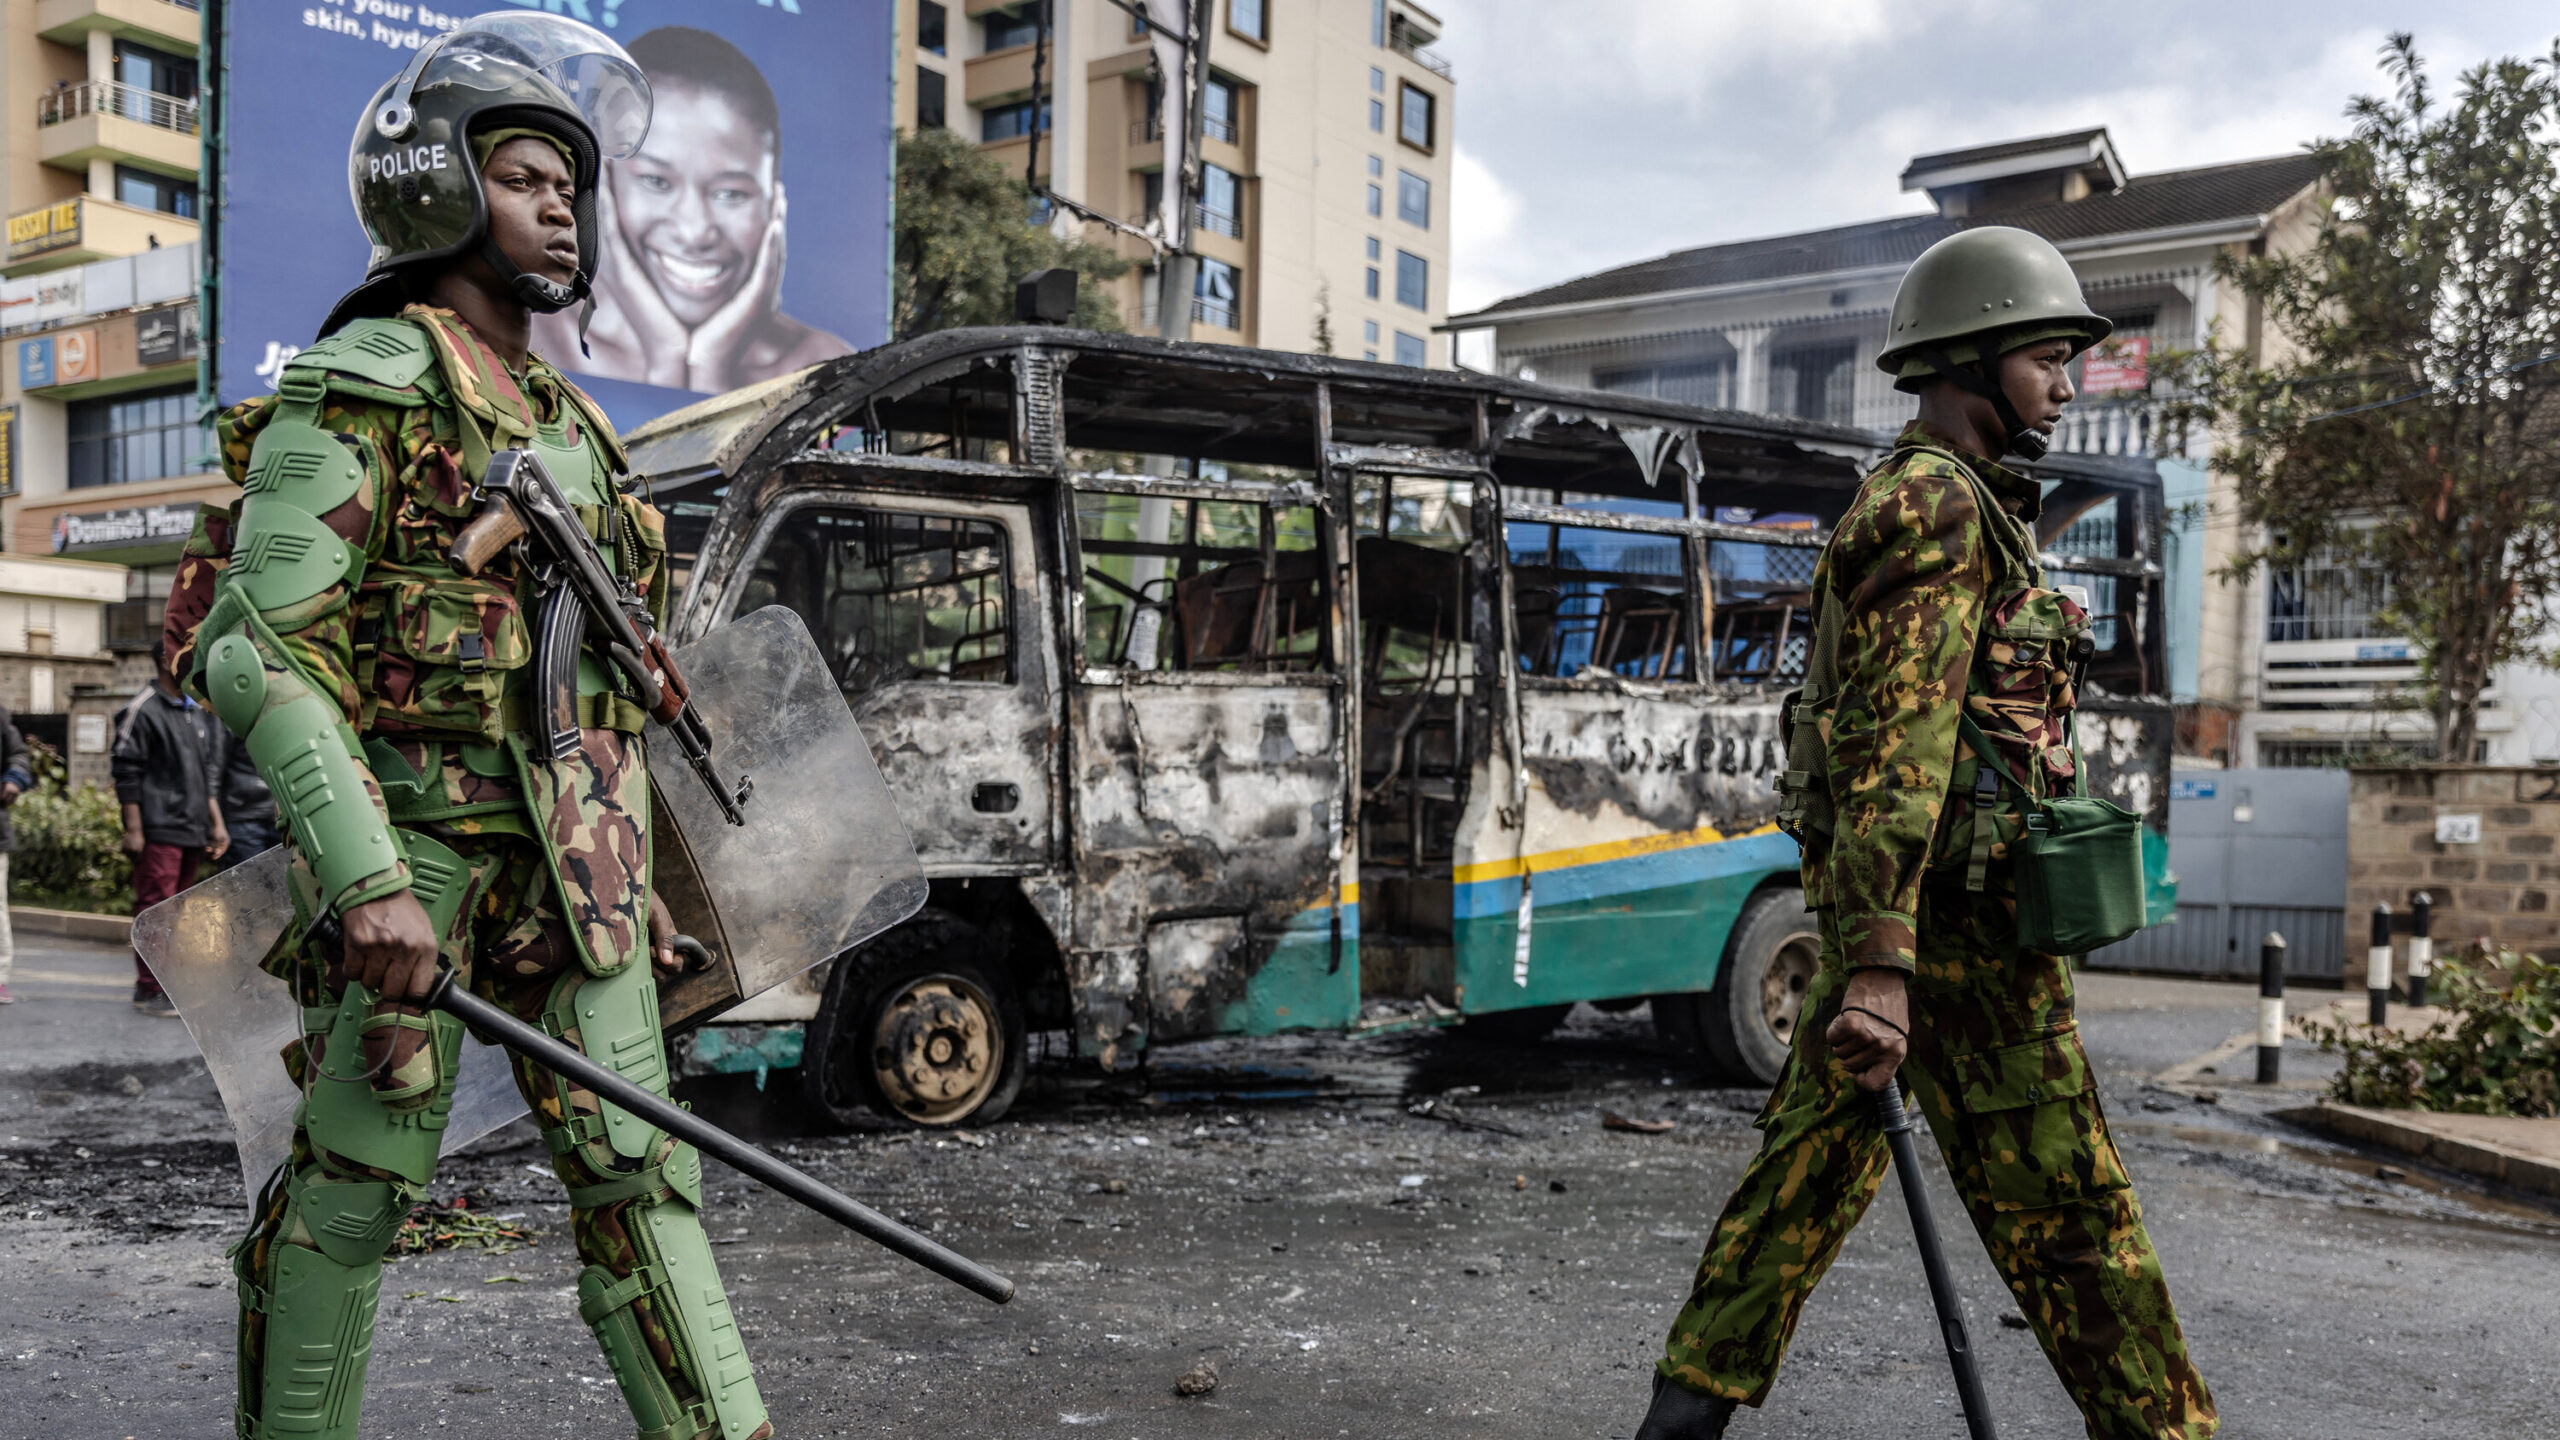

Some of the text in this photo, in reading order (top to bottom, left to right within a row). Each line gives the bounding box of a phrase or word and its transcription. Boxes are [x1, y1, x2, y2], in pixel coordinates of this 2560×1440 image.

[302, 7, 367, 40] skin,
[418, 4, 467, 31] bes
[370, 144, 447, 183] POLICE
